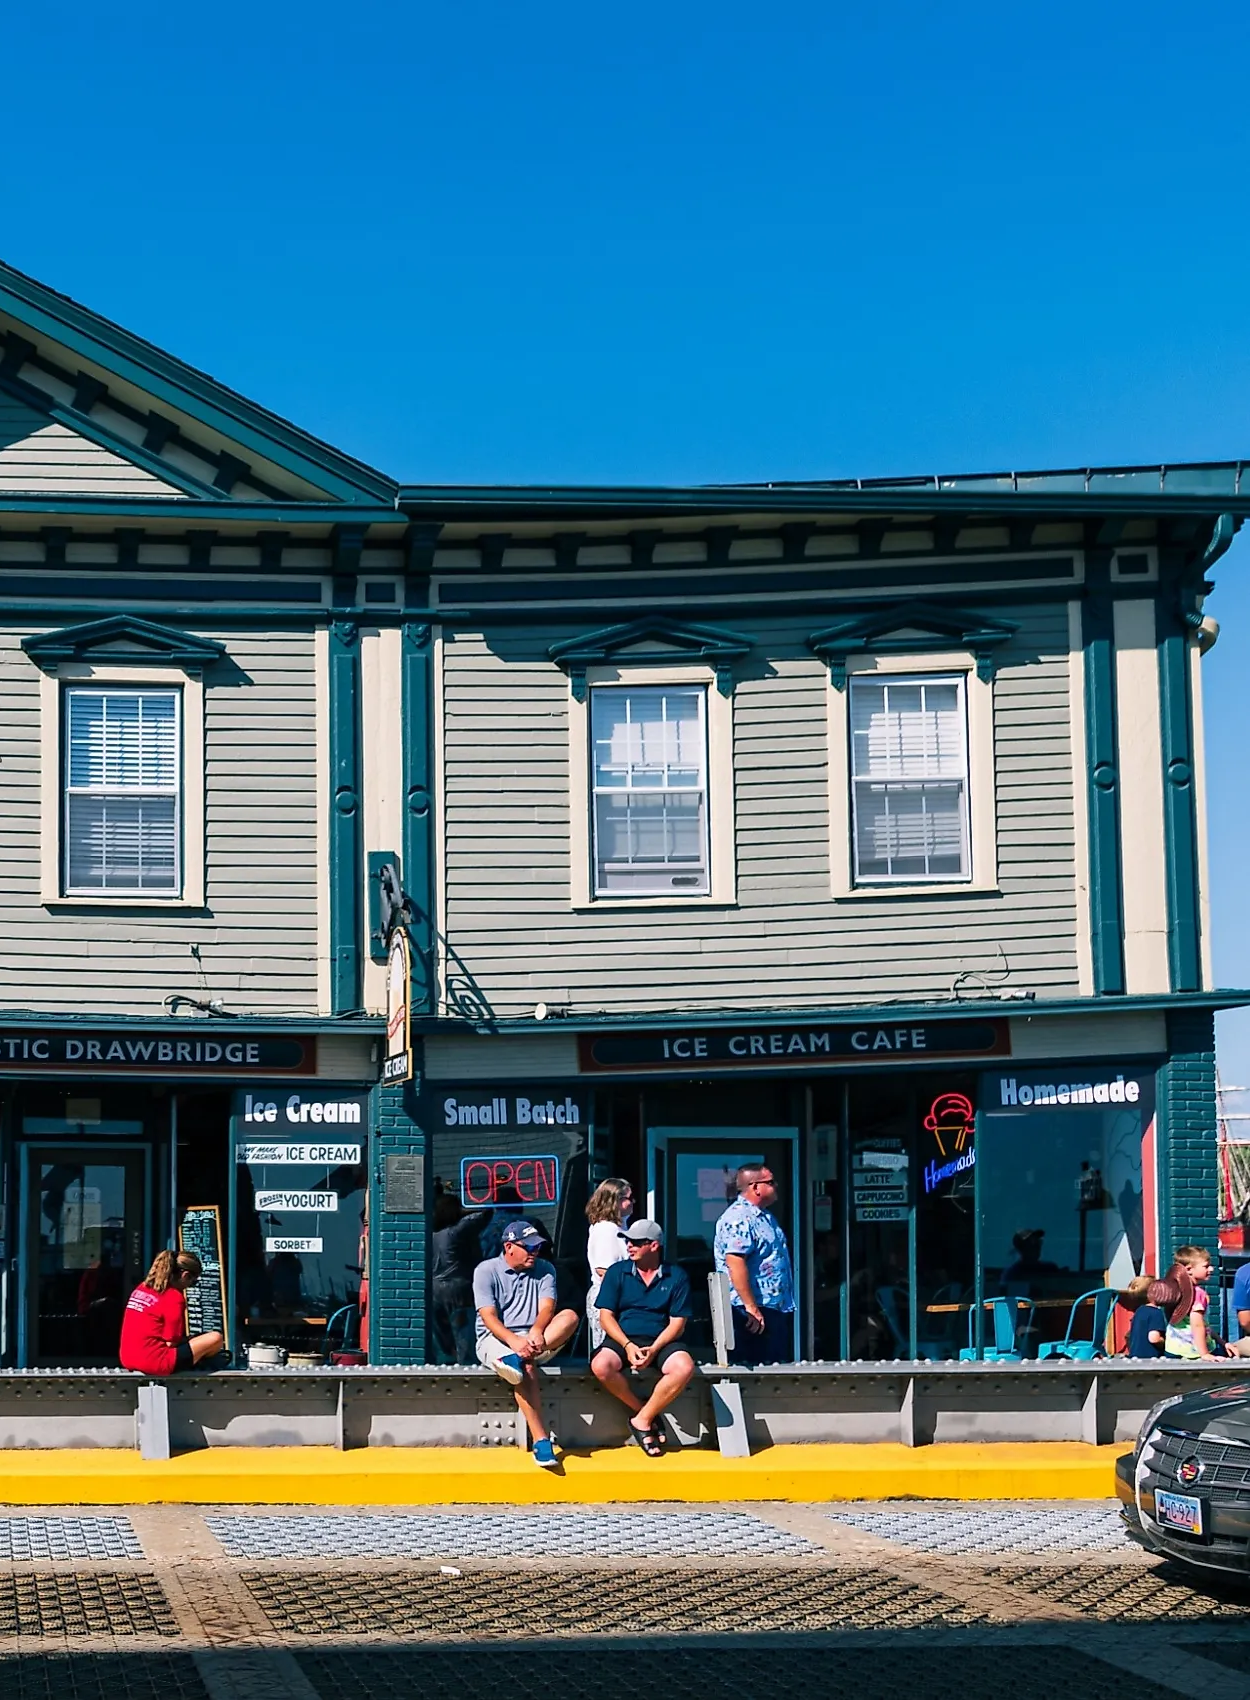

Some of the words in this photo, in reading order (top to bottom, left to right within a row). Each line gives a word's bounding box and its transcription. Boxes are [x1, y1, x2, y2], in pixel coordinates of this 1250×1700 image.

[65, 1040, 260, 1064] DRAWBRIDGE
[662, 1037, 709, 1058] ICE
[728, 1033, 831, 1056] CREAM
[851, 1028, 928, 1050] CAFE
[384, 1060, 393, 1078] ICE
[393, 1055, 408, 1076] CREAM
[1000, 1075, 1140, 1106] Homemade
[244, 1094, 278, 1123] Ice
[285, 1095, 361, 1124] Cream
[444, 1097, 507, 1126] Small
[516, 1097, 580, 1125] Batch
[251, 1153, 284, 1161] FASHION
[286, 1147, 305, 1161] ICE
[309, 1147, 358, 1161] CREAM
[465, 1159, 556, 1204] OPEN
[259, 1193, 283, 1205] FROZEN
[284, 1194, 333, 1208] YOGURT
[862, 1208, 901, 1219] COOKIES
[273, 1239, 312, 1250] SORBET
